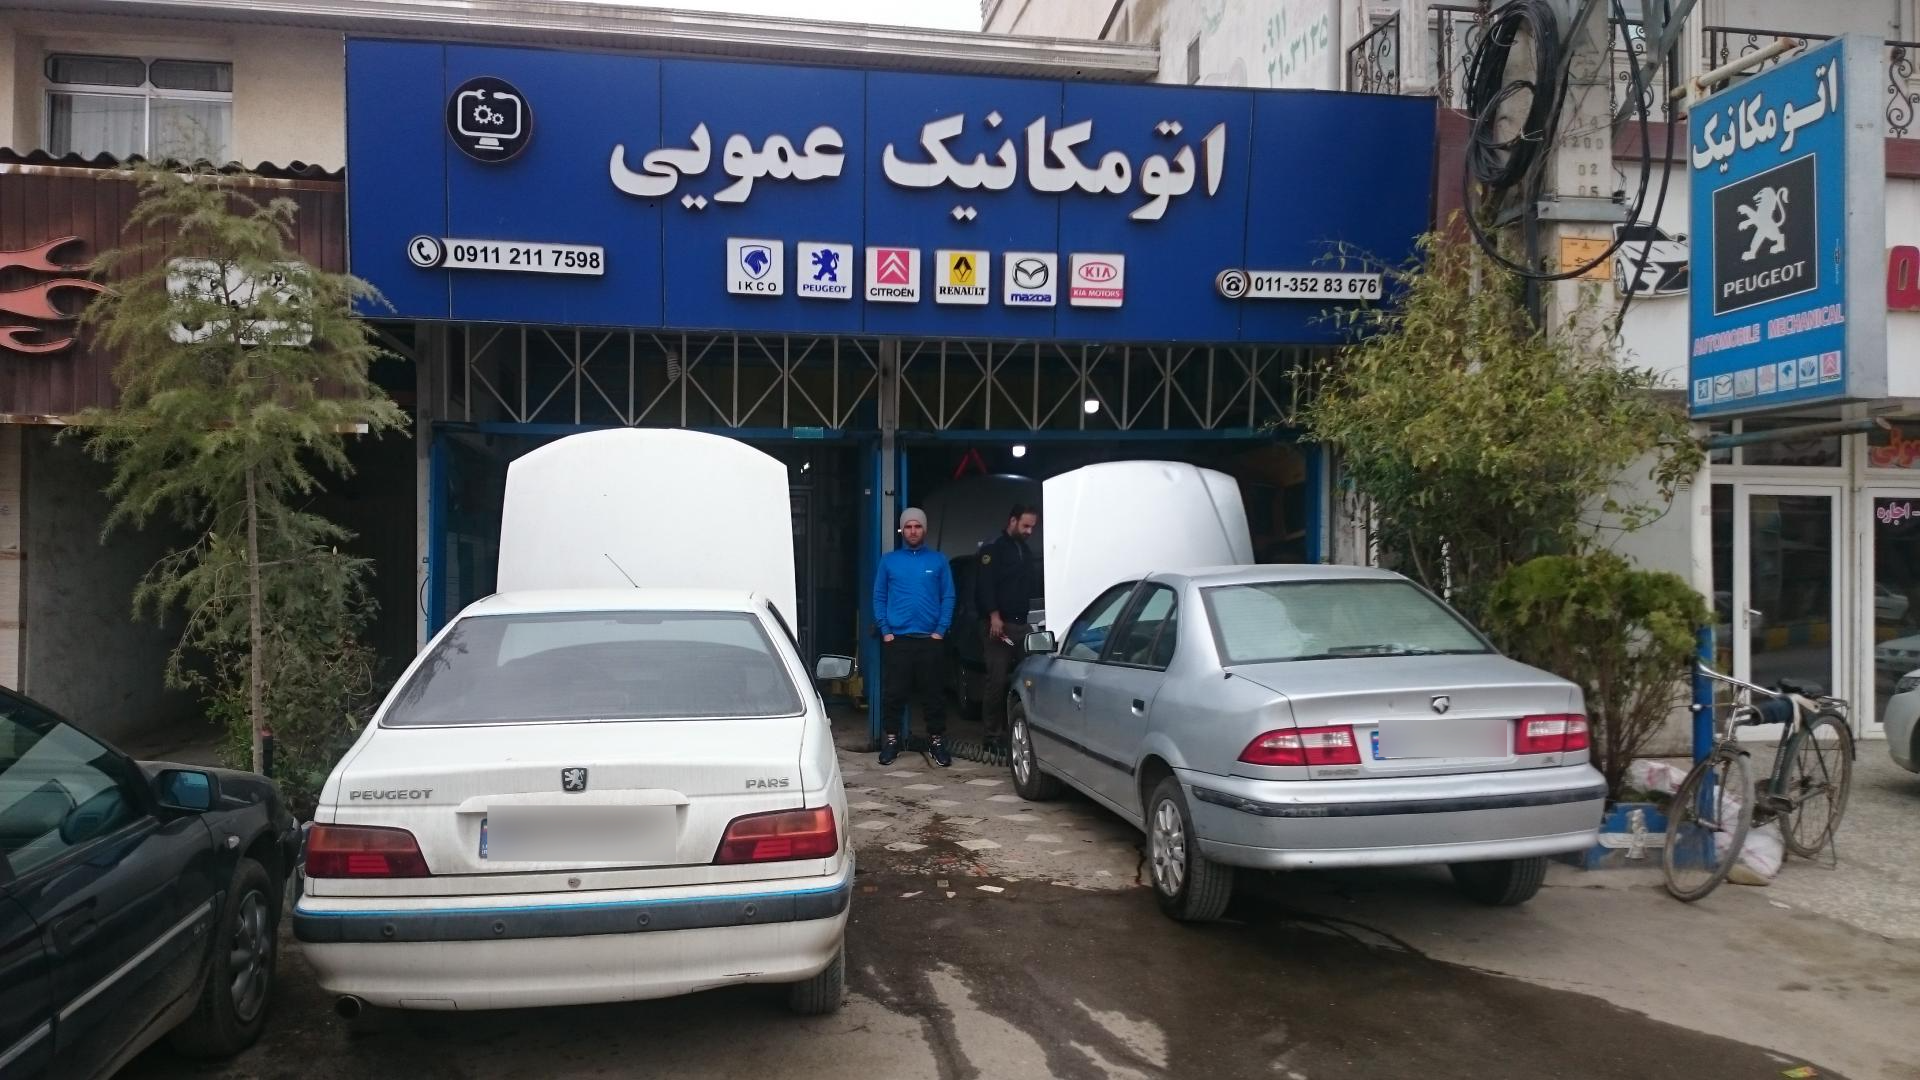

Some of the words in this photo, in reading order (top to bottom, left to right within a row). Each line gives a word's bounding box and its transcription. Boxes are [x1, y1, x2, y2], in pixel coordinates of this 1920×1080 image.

[609, 121, 845, 210] عمویی
[882, 110, 1226, 221] اتومکانیک
[453, 244, 500, 263] 0911
[509, 247, 543, 266] 211
[551, 250, 601, 269] 7598
[1085, 266, 1111, 278] KIA
[1723, 260, 1806, 298] PEUGEOT
[802, 283, 847, 294] PEUGEOT
[869, 287, 915, 298] CITROËN
[939, 286, 987, 296] RENAULT
[1254, 276, 1318, 292] 011-352
[1323, 278, 1343, 293] 83
[1348, 278, 1377, 294] 676
[1073, 289, 1087, 297] KIA
[1088, 290, 1120, 298] MOTORS
[1692, 323, 1761, 357] AUTOMOBILE
[1767, 303, 1845, 340] MECHANICAL
[1876, 502, 1910, 526] اجاره
[745, 778, 790, 789] PARS
[349, 788, 434, 801] PEUGEOT
